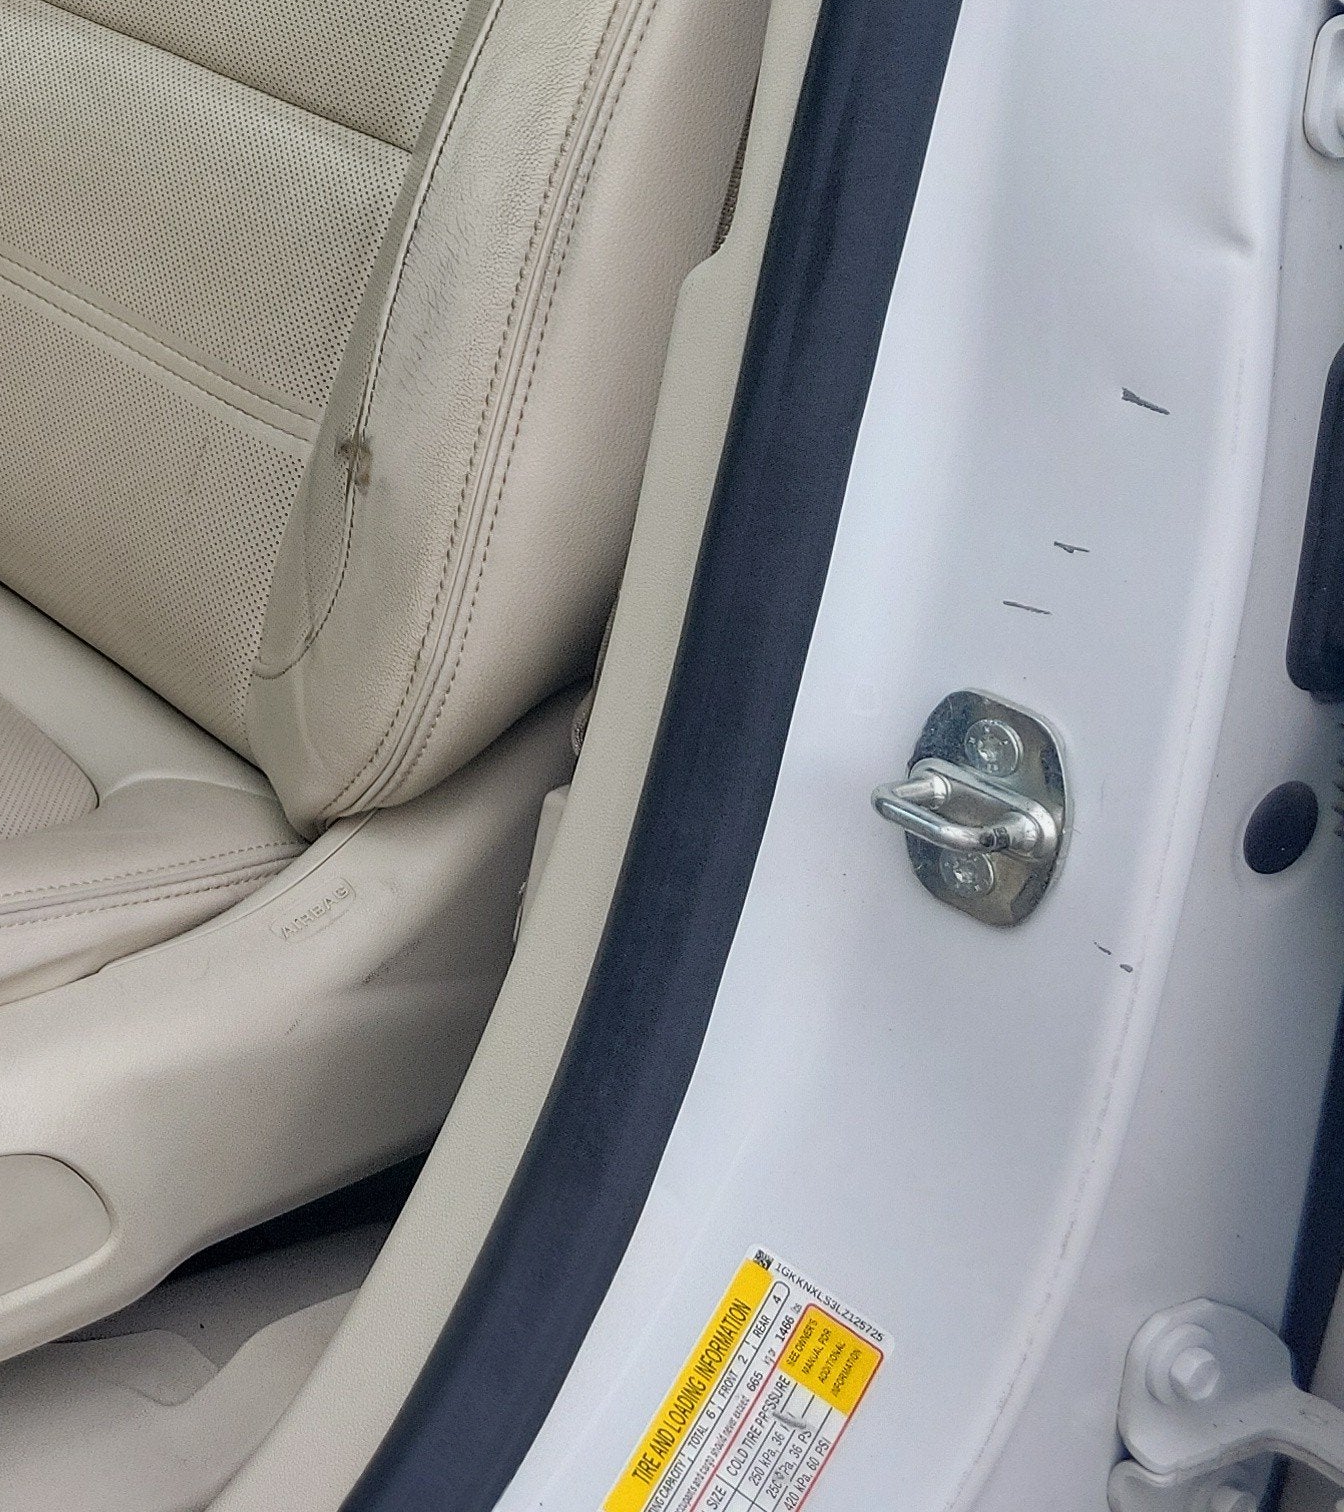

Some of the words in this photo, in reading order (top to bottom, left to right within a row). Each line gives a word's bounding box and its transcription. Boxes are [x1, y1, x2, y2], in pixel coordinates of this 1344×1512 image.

[280, 887, 351, 938] AIRBAG
[753, 1315, 770, 1338] REAR
[772, 1295, 781, 1304] 4
[718, 1370, 739, 1398] FRONT
[738, 1355, 748, 1364] 2
[747, 1371, 763, 1392] 665
[775, 1315, 795, 1342] 1466
[802, 1346, 823, 1375] MANUAL
[830, 1348, 862, 1397] INFORMATION
[633, 1453, 661, 1486] TIRE
[649, 1427, 676, 1459] AND
[664, 1377, 705, 1433] LOADING
[695, 1298, 751, 1381] INFORMATION
[689, 1425, 707, 1450] TOTAL
[707, 1410, 716, 1420] 6
[727, 1448, 748, 1477] COLD
[743, 1424, 762, 1449] TIRE
[789, 1445, 802, 1459] 36
[660, 1460, 686, 1499] CAPACITY
[749, 1466, 765, 1486] 250
[759, 1445, 779, 1469] kPa,
[772, 1432, 785, 1446] 36
[783, 1492, 800, 1512] 420
[794, 1471, 812, 1493] kPa,
[806, 1456, 820, 1471] 60
[815, 1437, 831, 1457] PSI
[707, 1486, 726, 1511] SIZE
